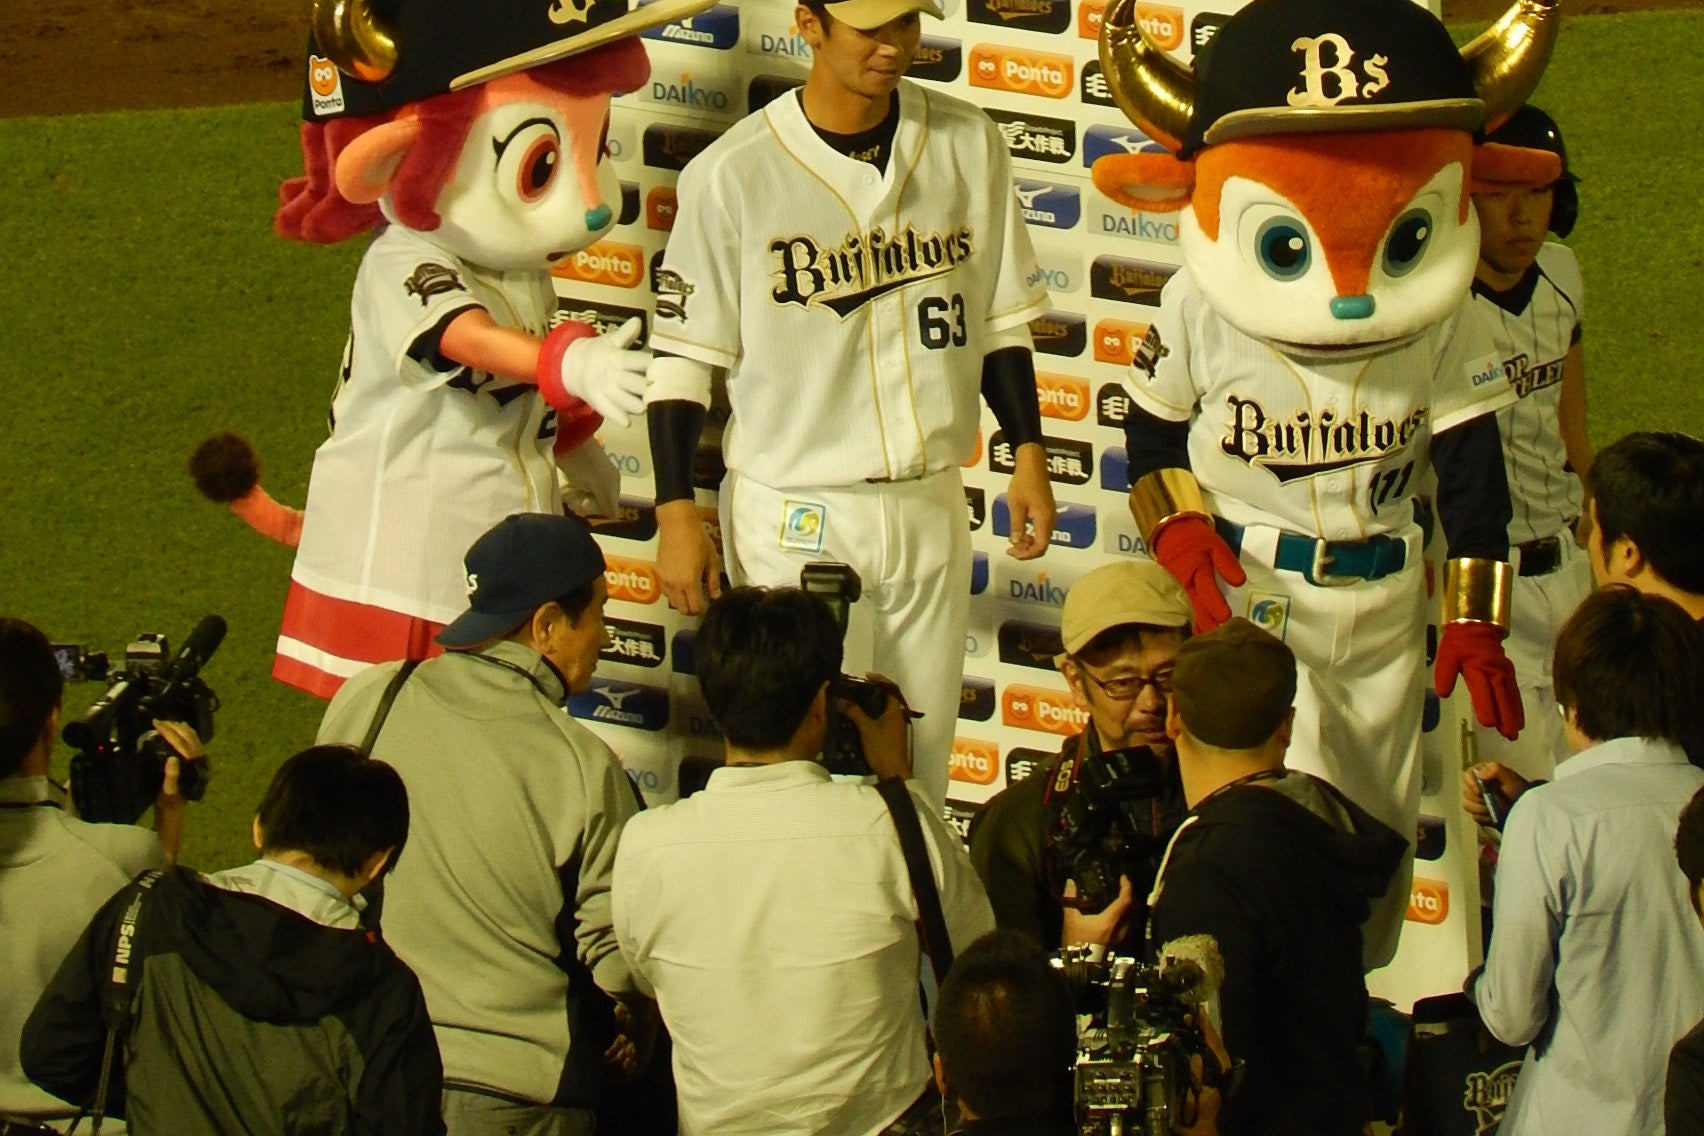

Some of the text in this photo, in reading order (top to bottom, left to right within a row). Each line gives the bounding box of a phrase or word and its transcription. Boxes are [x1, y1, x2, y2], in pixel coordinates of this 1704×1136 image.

[1003, 61, 1062, 87] Ponta
[1286, 32, 1391, 107] Bs
[575, 250, 634, 274] Ponta
[771, 224, 974, 309] Buffaloes
[916, 292, 967, 350] 63
[1037, 389, 1080, 408] onta
[1219, 394, 1430, 464] Buffaloes
[603, 570, 650, 590] onta
[1055, 759, 1074, 792] EOS
[115, 924, 135, 964] NPS
